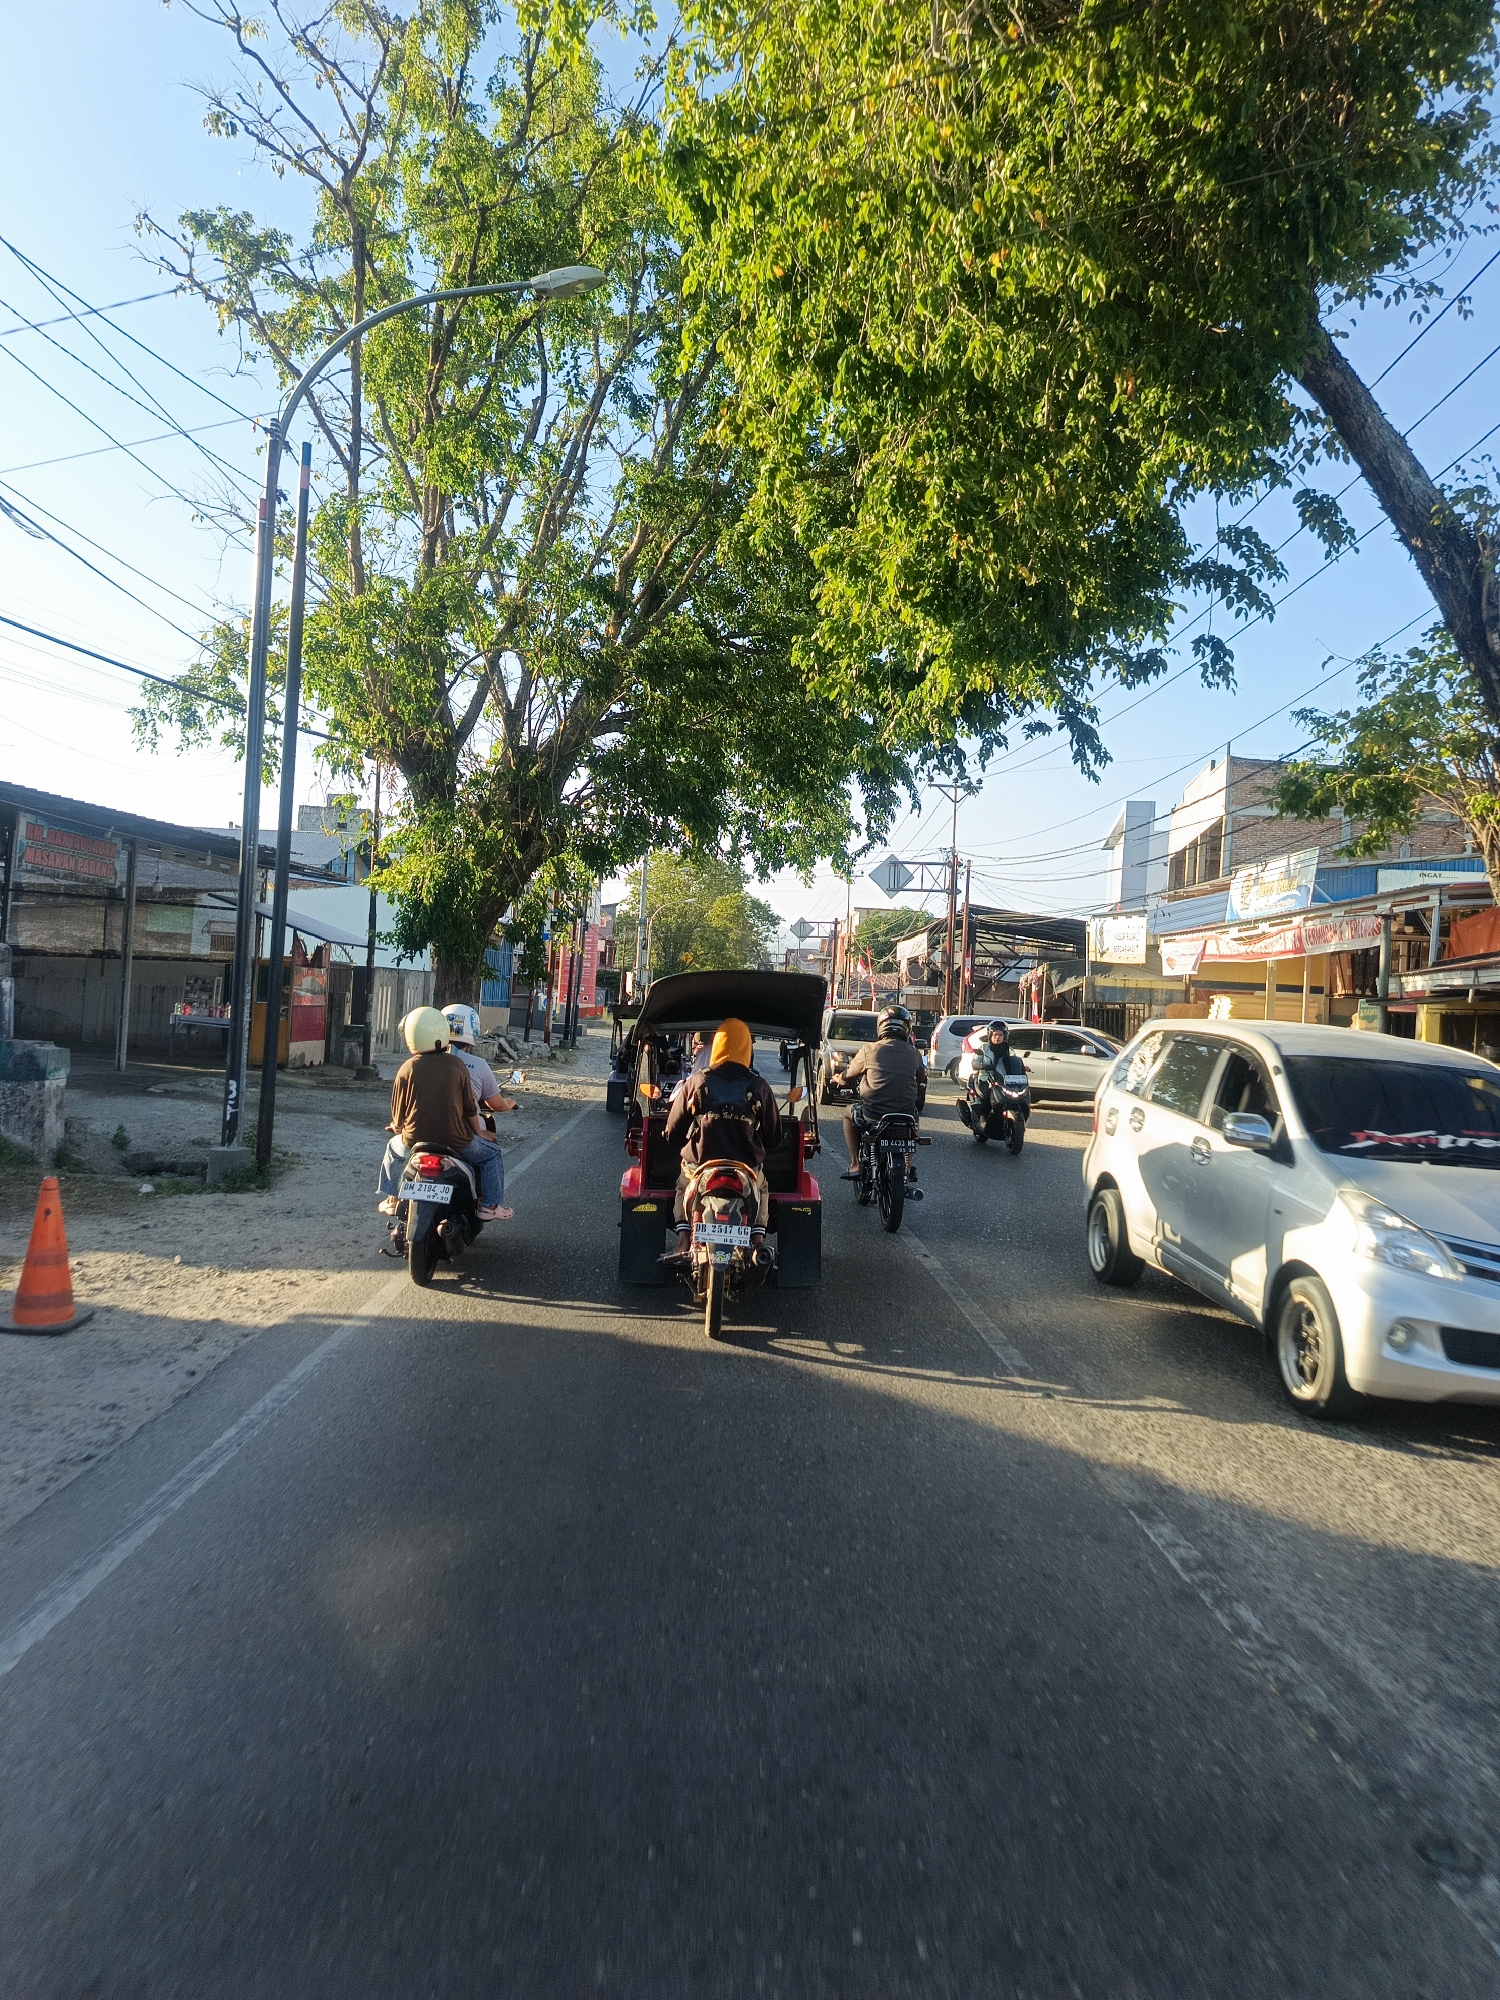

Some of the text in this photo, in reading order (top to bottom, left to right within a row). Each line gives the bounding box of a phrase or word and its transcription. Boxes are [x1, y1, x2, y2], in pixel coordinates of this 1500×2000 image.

[24, 845, 75, 871] MASAKAN
[77, 856, 113, 879] PADANG
[417, 1184, 436, 1193] 2194
[695, 1224, 707, 1233] DB
[711, 1225, 734, 1235] 2547
